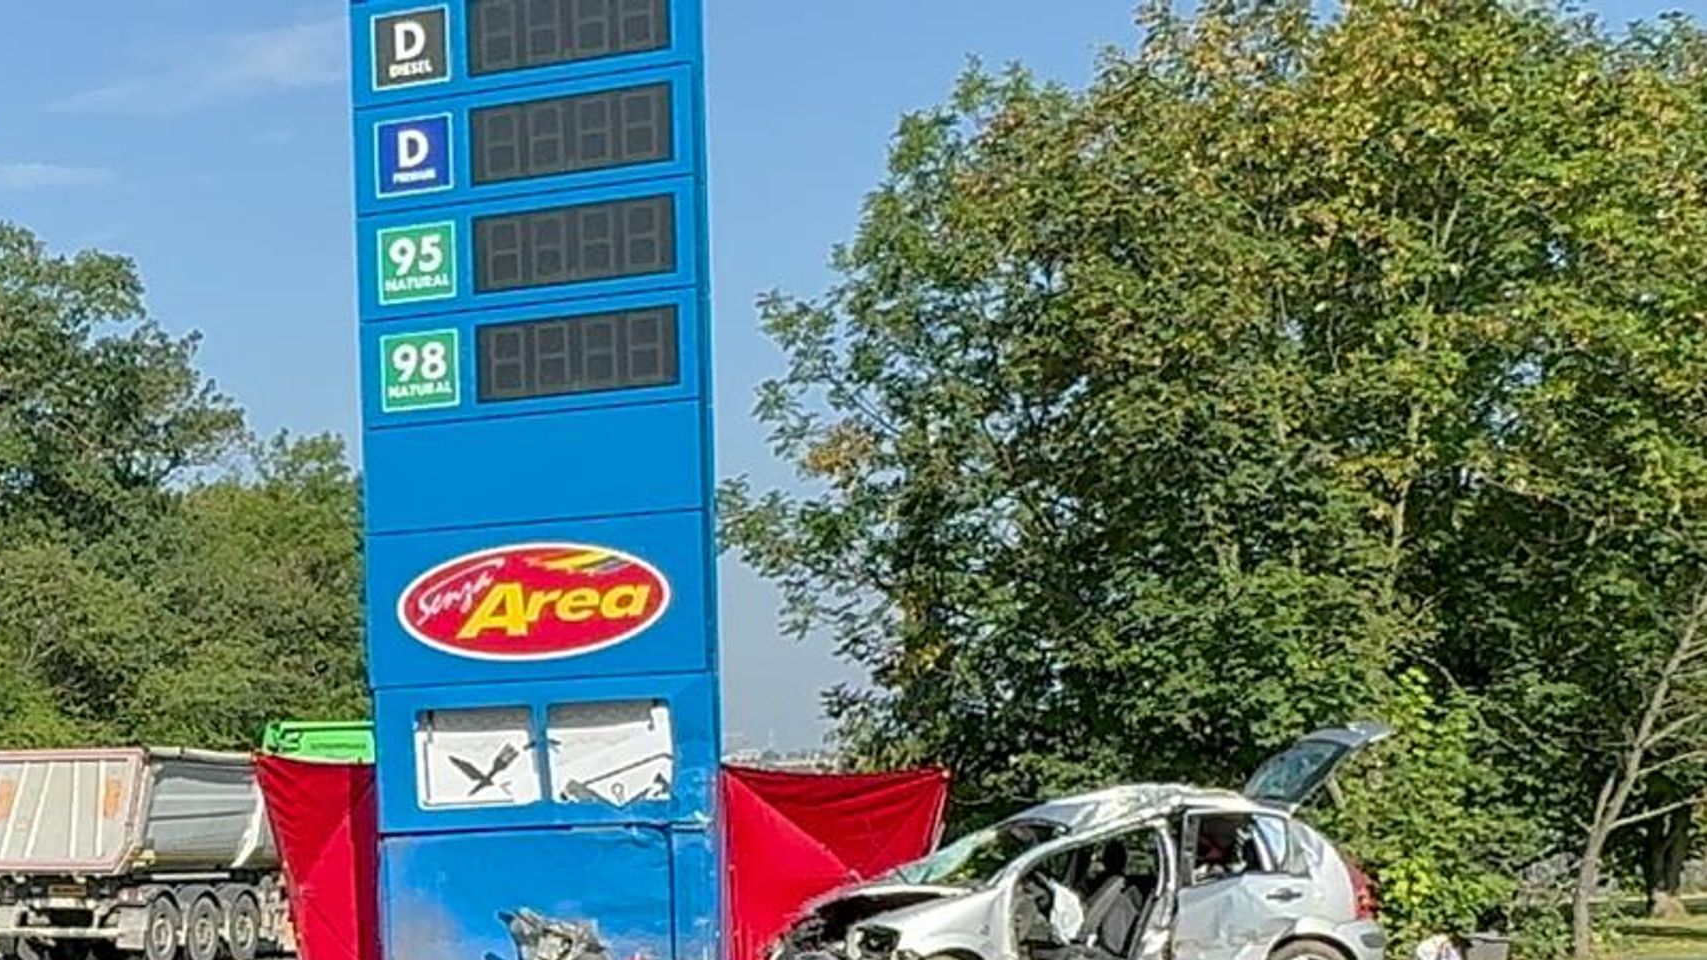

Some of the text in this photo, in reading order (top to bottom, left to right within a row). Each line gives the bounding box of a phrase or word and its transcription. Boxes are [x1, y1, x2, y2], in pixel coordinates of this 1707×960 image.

[394, 21, 426, 61] D
[389, 59, 433, 78] DIESEL
[397, 129, 429, 168] D
[389, 234, 443, 276] 95
[384, 273, 450, 292] NATURAL
[393, 341, 447, 383] 98
[387, 380, 452, 399] NATURAL
[416, 557, 651, 639] Senza Area
